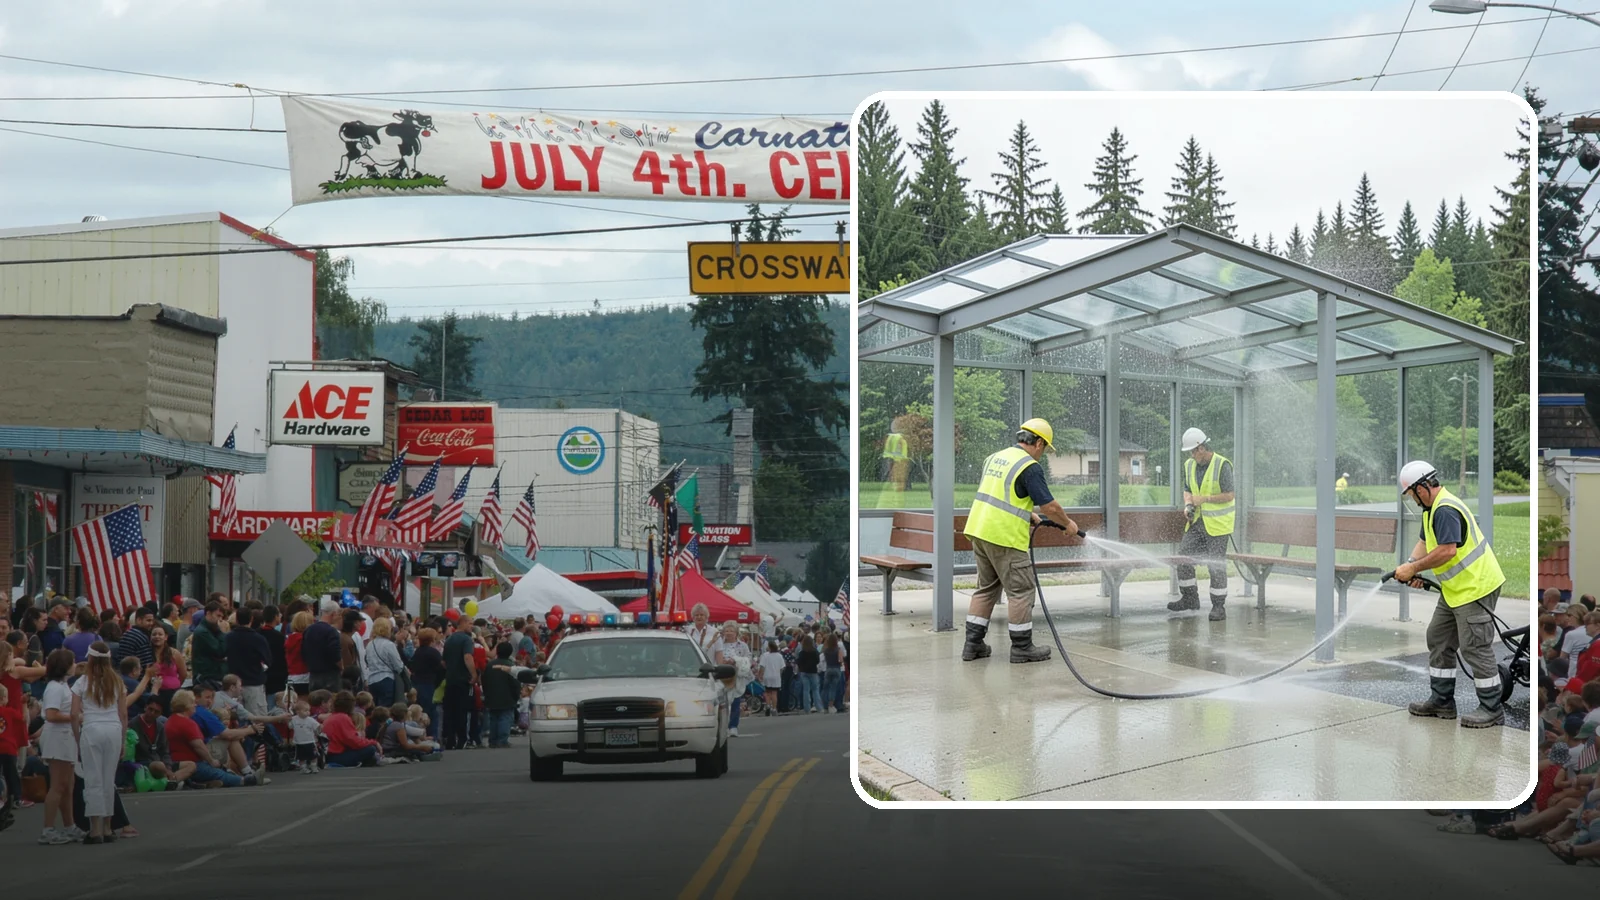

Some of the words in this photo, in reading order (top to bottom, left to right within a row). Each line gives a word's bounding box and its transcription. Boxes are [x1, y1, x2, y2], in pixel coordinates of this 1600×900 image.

[695, 121, 850, 149] Carnat
[481, 140, 605, 192] JULY
[632, 150, 746, 198] 4th.
[697, 254, 850, 280] CROSSWA
[282, 379, 374, 420] ACE
[406, 409, 452, 422] CEDAR
[461, 409, 485, 422] LOG
[283, 421, 371, 436] Hardware
[83, 484, 94, 495] St.
[95, 484, 125, 495] Vincent
[126, 485, 136, 495] de
[138, 486, 155, 495] Paul
[688, 526, 741, 535] CRNATION
[699, 535, 730, 543] GLASS
